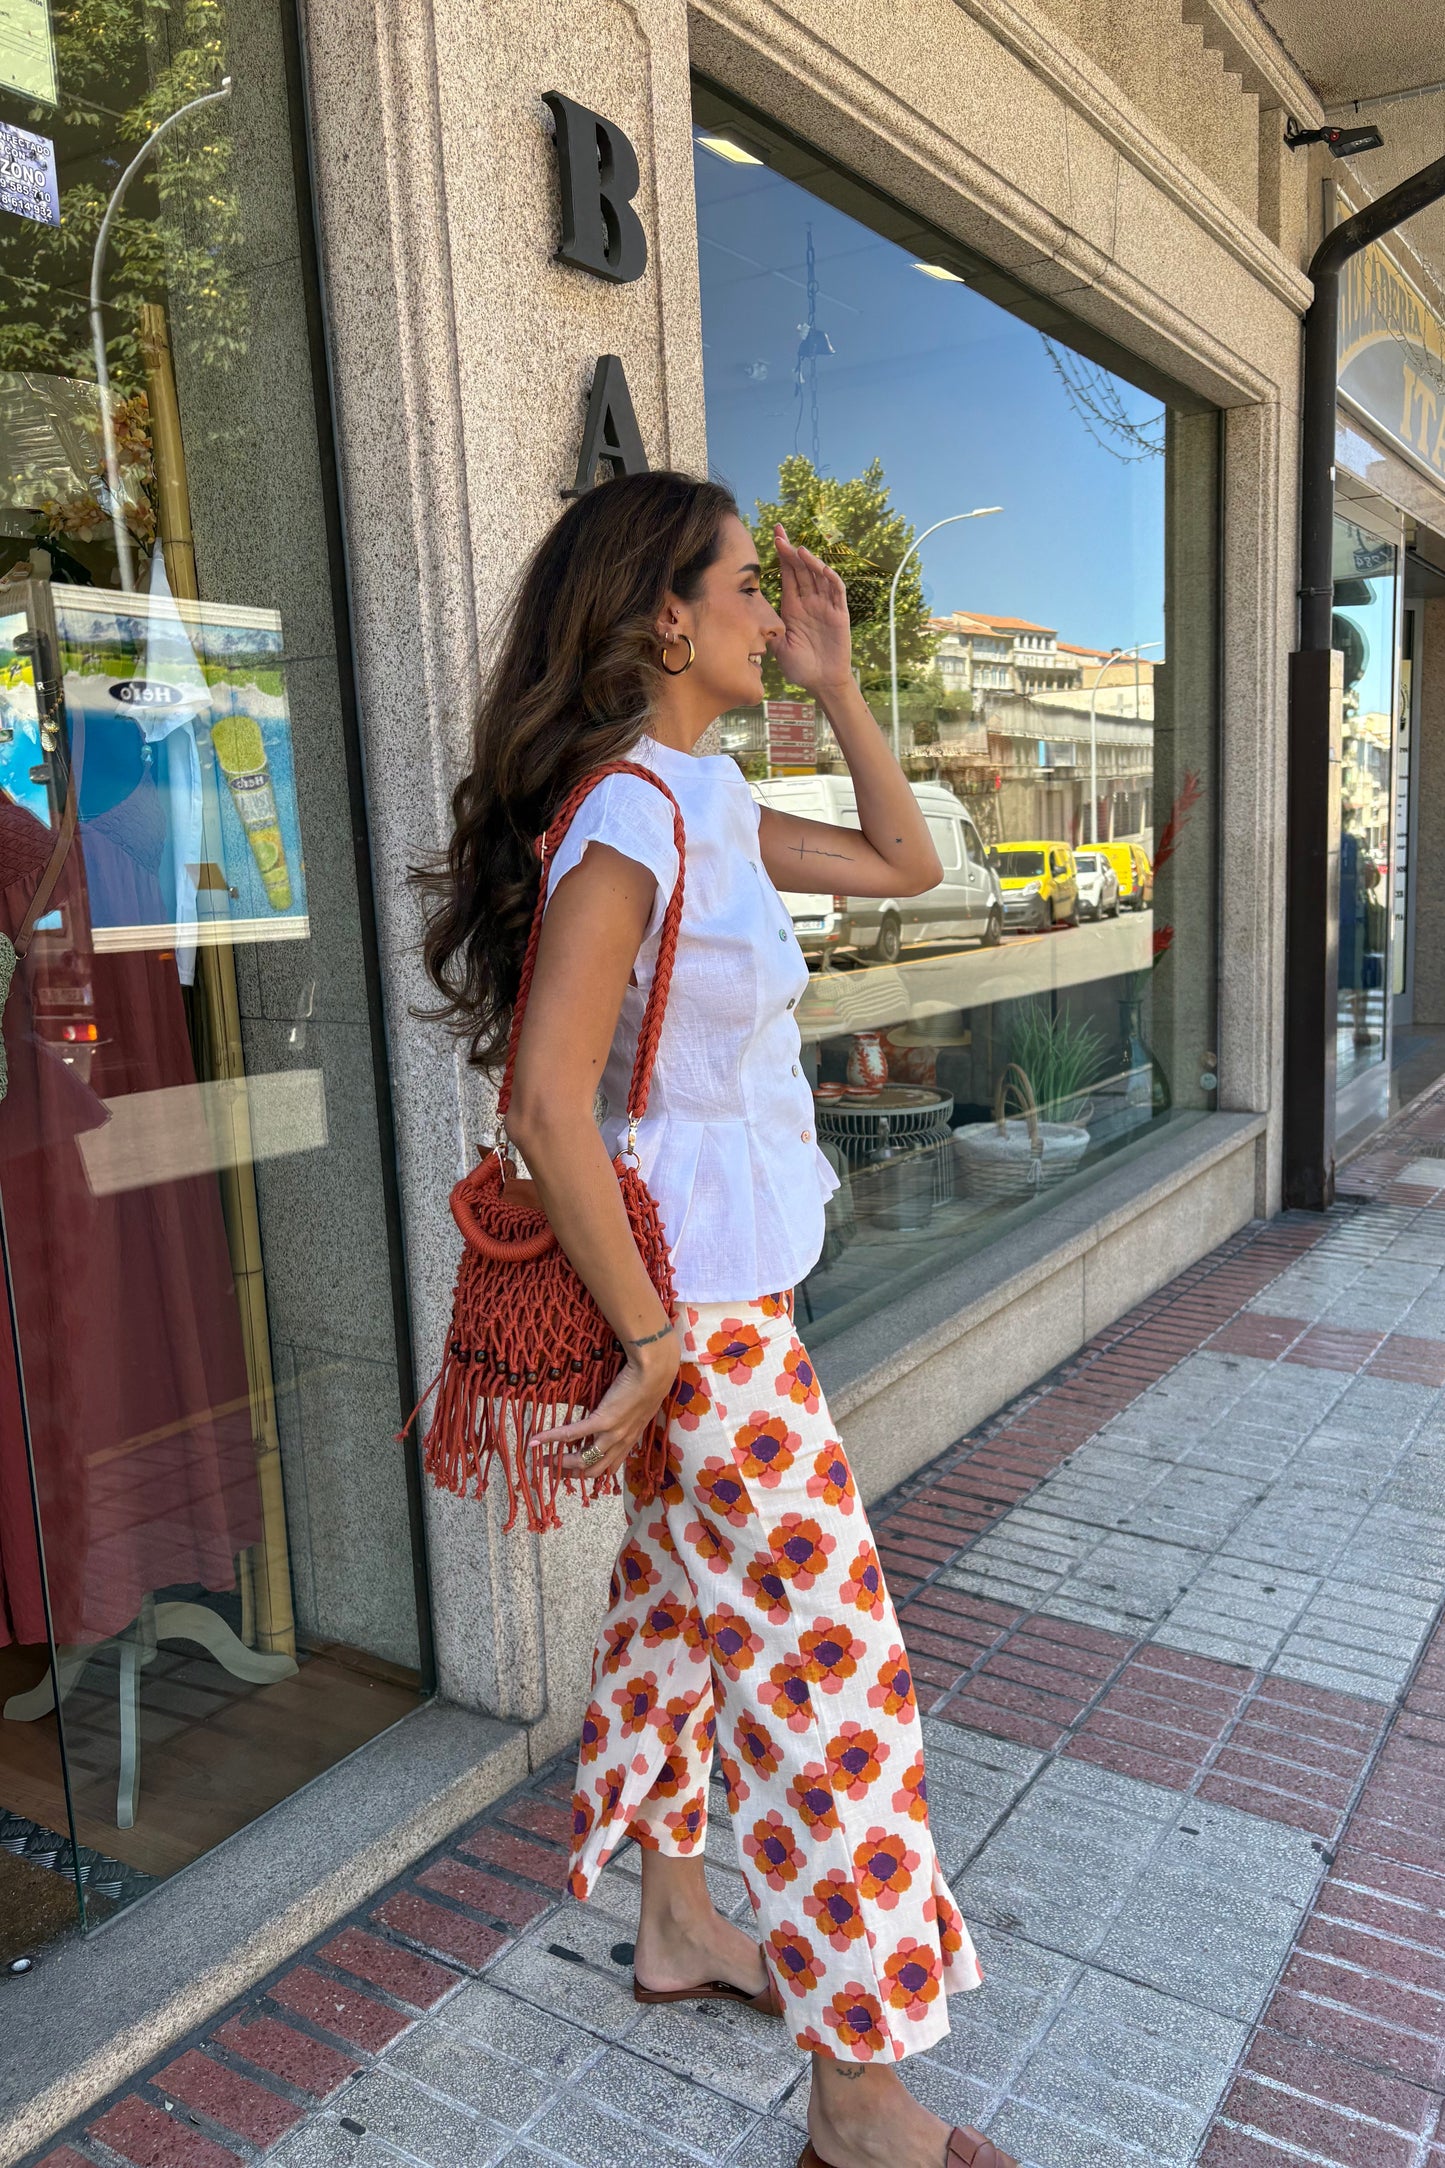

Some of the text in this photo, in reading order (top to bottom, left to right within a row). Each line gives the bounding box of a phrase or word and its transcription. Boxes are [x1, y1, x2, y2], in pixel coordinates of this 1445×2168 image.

[5, 146, 26, 160] CON
[0, 158, 46, 187] ZONO
[10, 182, 29, 196] 585
[11, 197, 31, 211] 614
[33, 205, 53, 218] 932
